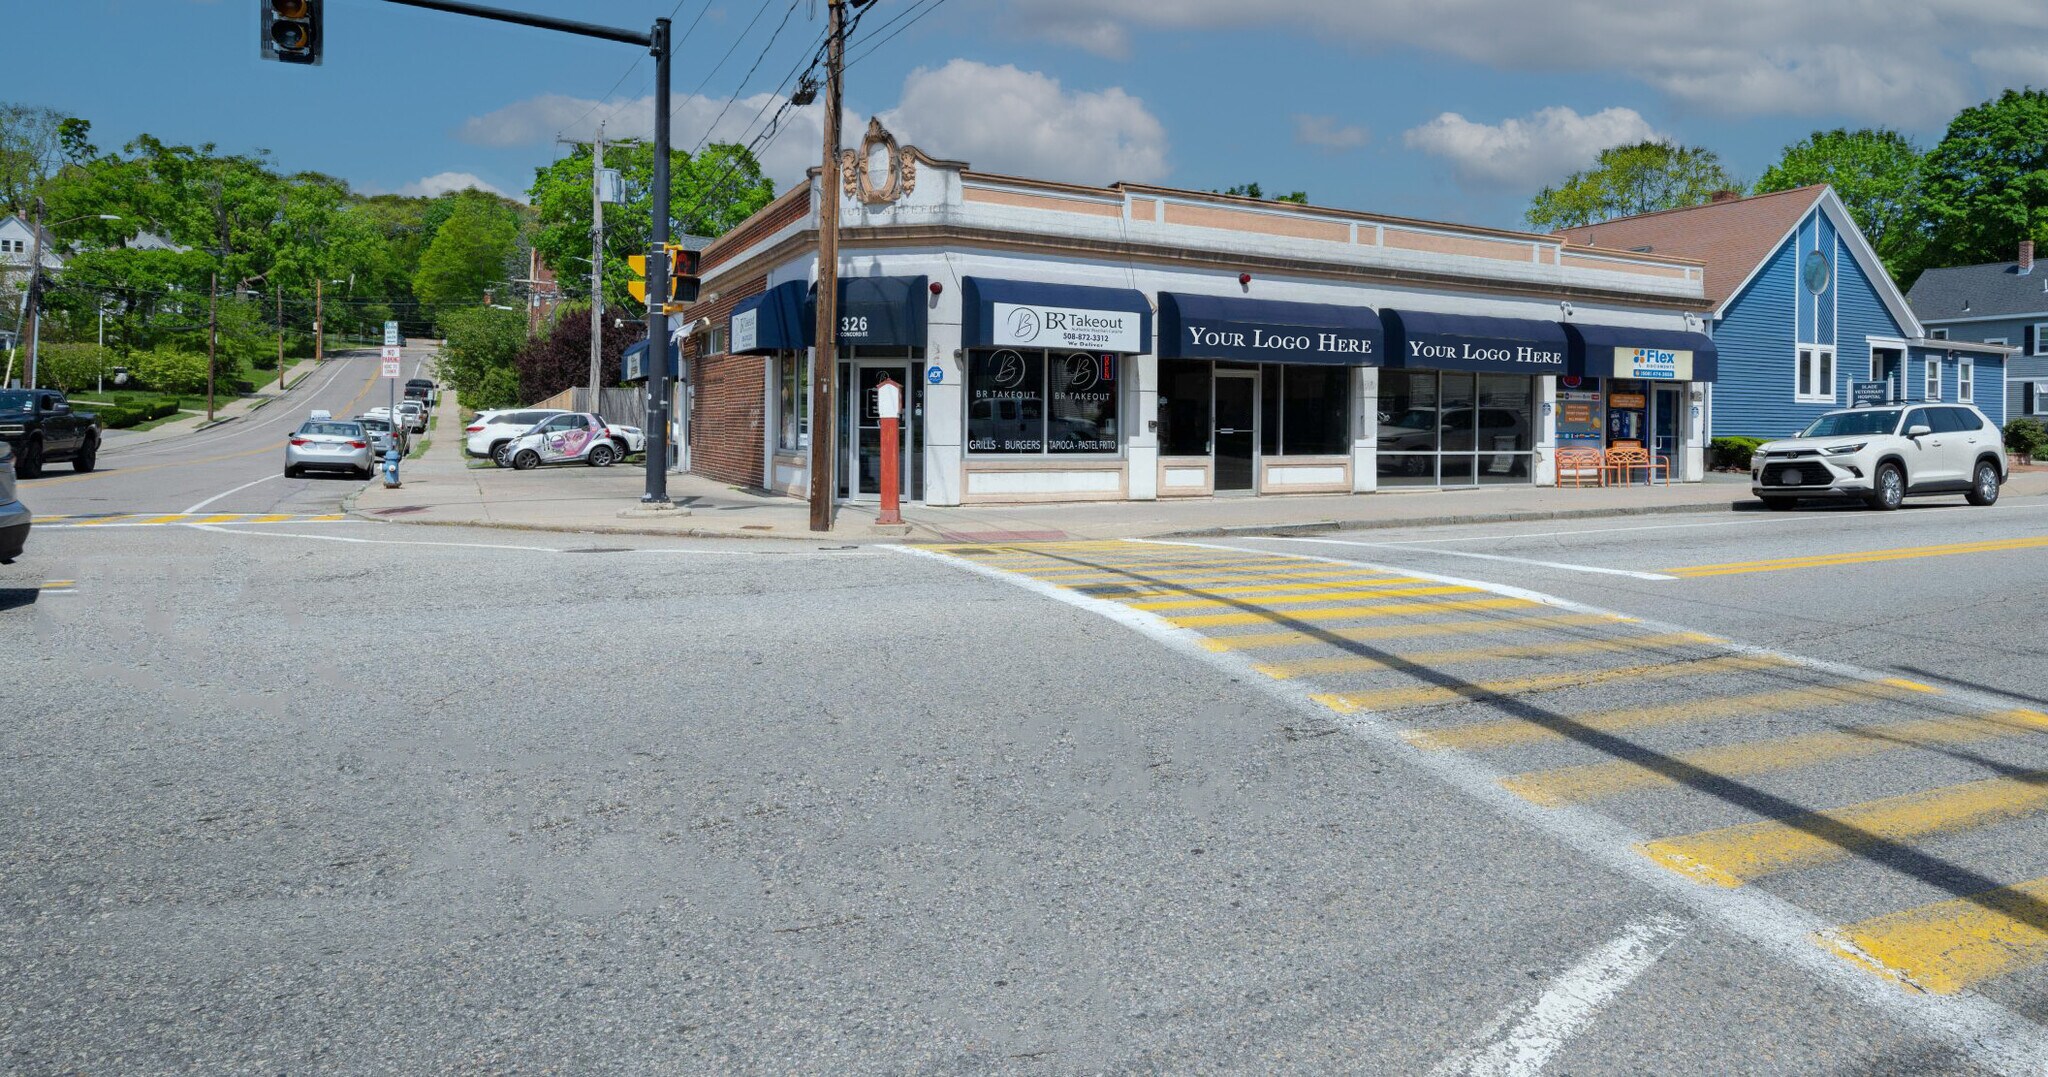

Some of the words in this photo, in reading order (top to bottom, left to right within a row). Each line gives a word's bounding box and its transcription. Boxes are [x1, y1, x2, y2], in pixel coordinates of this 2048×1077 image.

[841, 316, 868, 331] 326
[1045, 312, 1068, 331] BR
[1069, 313, 1123, 329] Takeout
[1063, 332, 1109, 342] 508-872-3312
[1647, 350, 1674, 363] Flex
[929, 370, 942, 378] ADT
[976, 390, 988, 398] BR
[992, 391, 1036, 399] TAKEOUT
[1054, 392, 1066, 400] BR
[1070, 392, 1110, 400] TAKEOUT
[969, 440, 997, 450] GRILLS
[1005, 440, 1041, 450] BURGERS
[1049, 440, 1074, 450] TAPIOCA
[1078, 440, 1099, 450] PASTEL
[1099, 440, 1116, 450] FRITO
